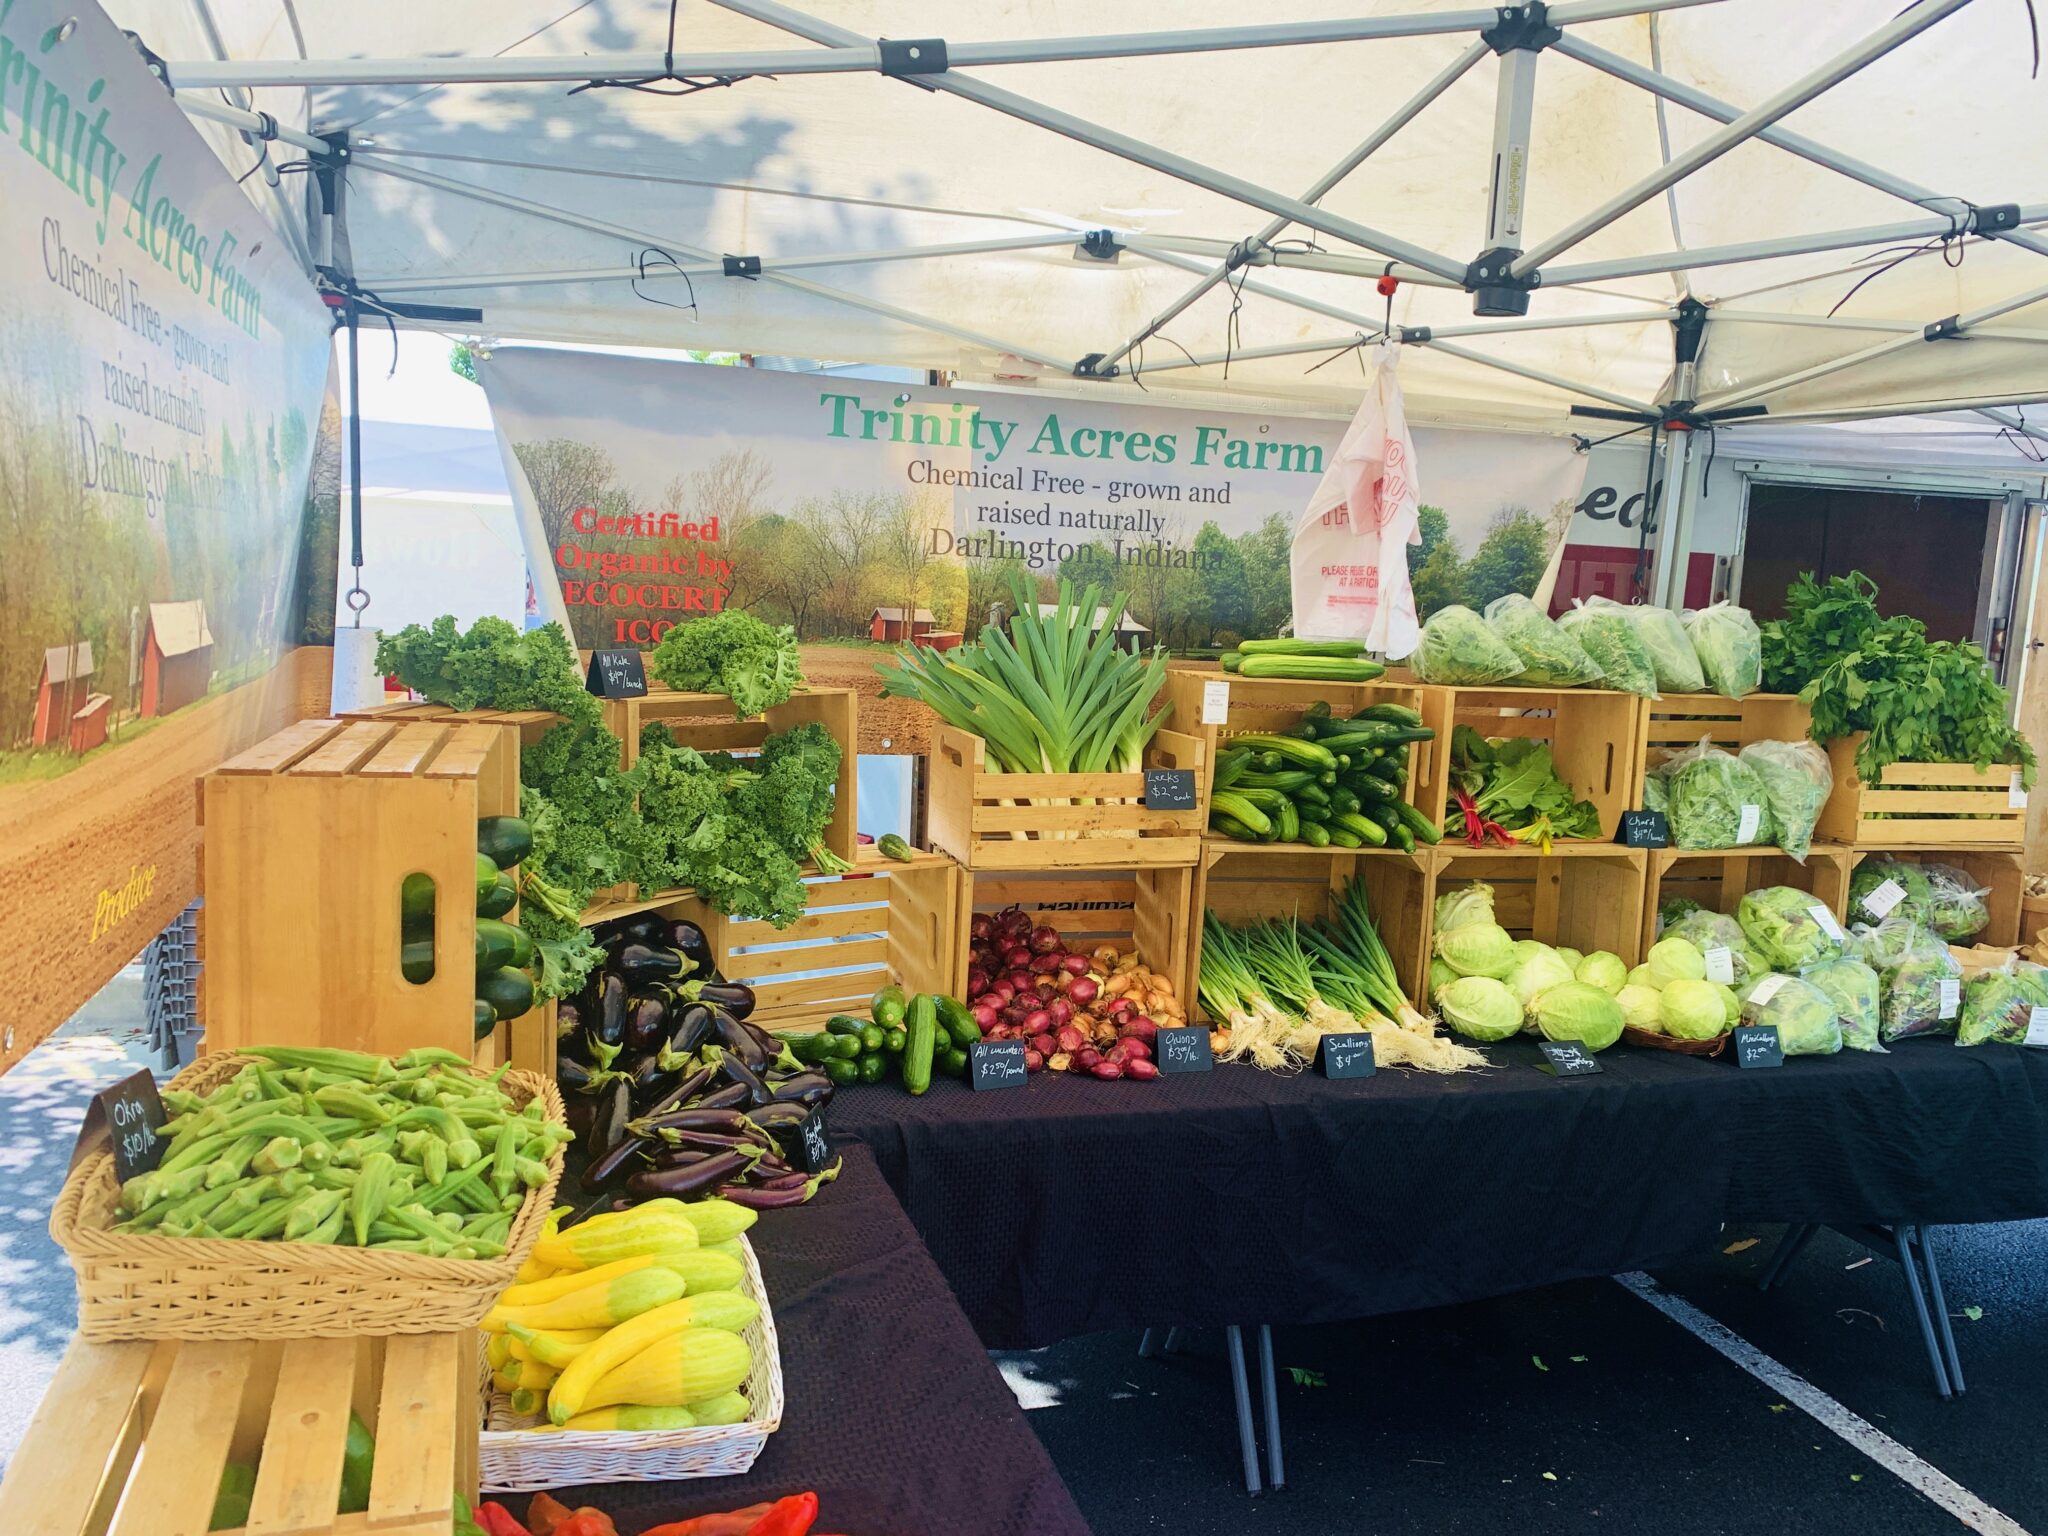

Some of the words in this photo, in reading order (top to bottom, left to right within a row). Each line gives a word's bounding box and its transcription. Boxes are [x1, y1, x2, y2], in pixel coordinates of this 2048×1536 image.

[0, 0, 127, 245] rinity
[122, 153, 210, 295] Acres
[207, 229, 262, 341] Farm
[42, 216, 128, 327] Chemical
[129, 279, 163, 346] Free
[173, 323, 209, 371] grown
[210, 343, 231, 386] and
[102, 351, 151, 417] raised
[152, 384, 207, 450] naturally
[820, 393, 1019, 462] Trinity
[1027, 413, 1177, 464] Acres
[1190, 426, 1324, 474] Farm
[907, 460, 1023, 491] Chemical
[1031, 469, 1085, 495] Free
[1107, 480, 1181, 503] grown
[1188, 482, 1231, 504] and
[572, 507, 720, 542] Certified
[977, 500, 1051, 526] raised
[1058, 509, 1166, 538] naturally
[556, 543, 690, 577] Organic
[696, 550, 736, 584] by
[1112, 539, 1223, 569] Indiana
[1321, 565, 1349, 576] PLEASE
[563, 580, 730, 612] ECOCERT
[1147, 771, 1180, 783] Leeks
[1628, 815, 1655, 828] Chard
[89, 864, 157, 944] Produce
[975, 1045, 989, 1058] All
[1328, 1037, 1370, 1052] Scallions
[114, 1098, 145, 1126] Okra
